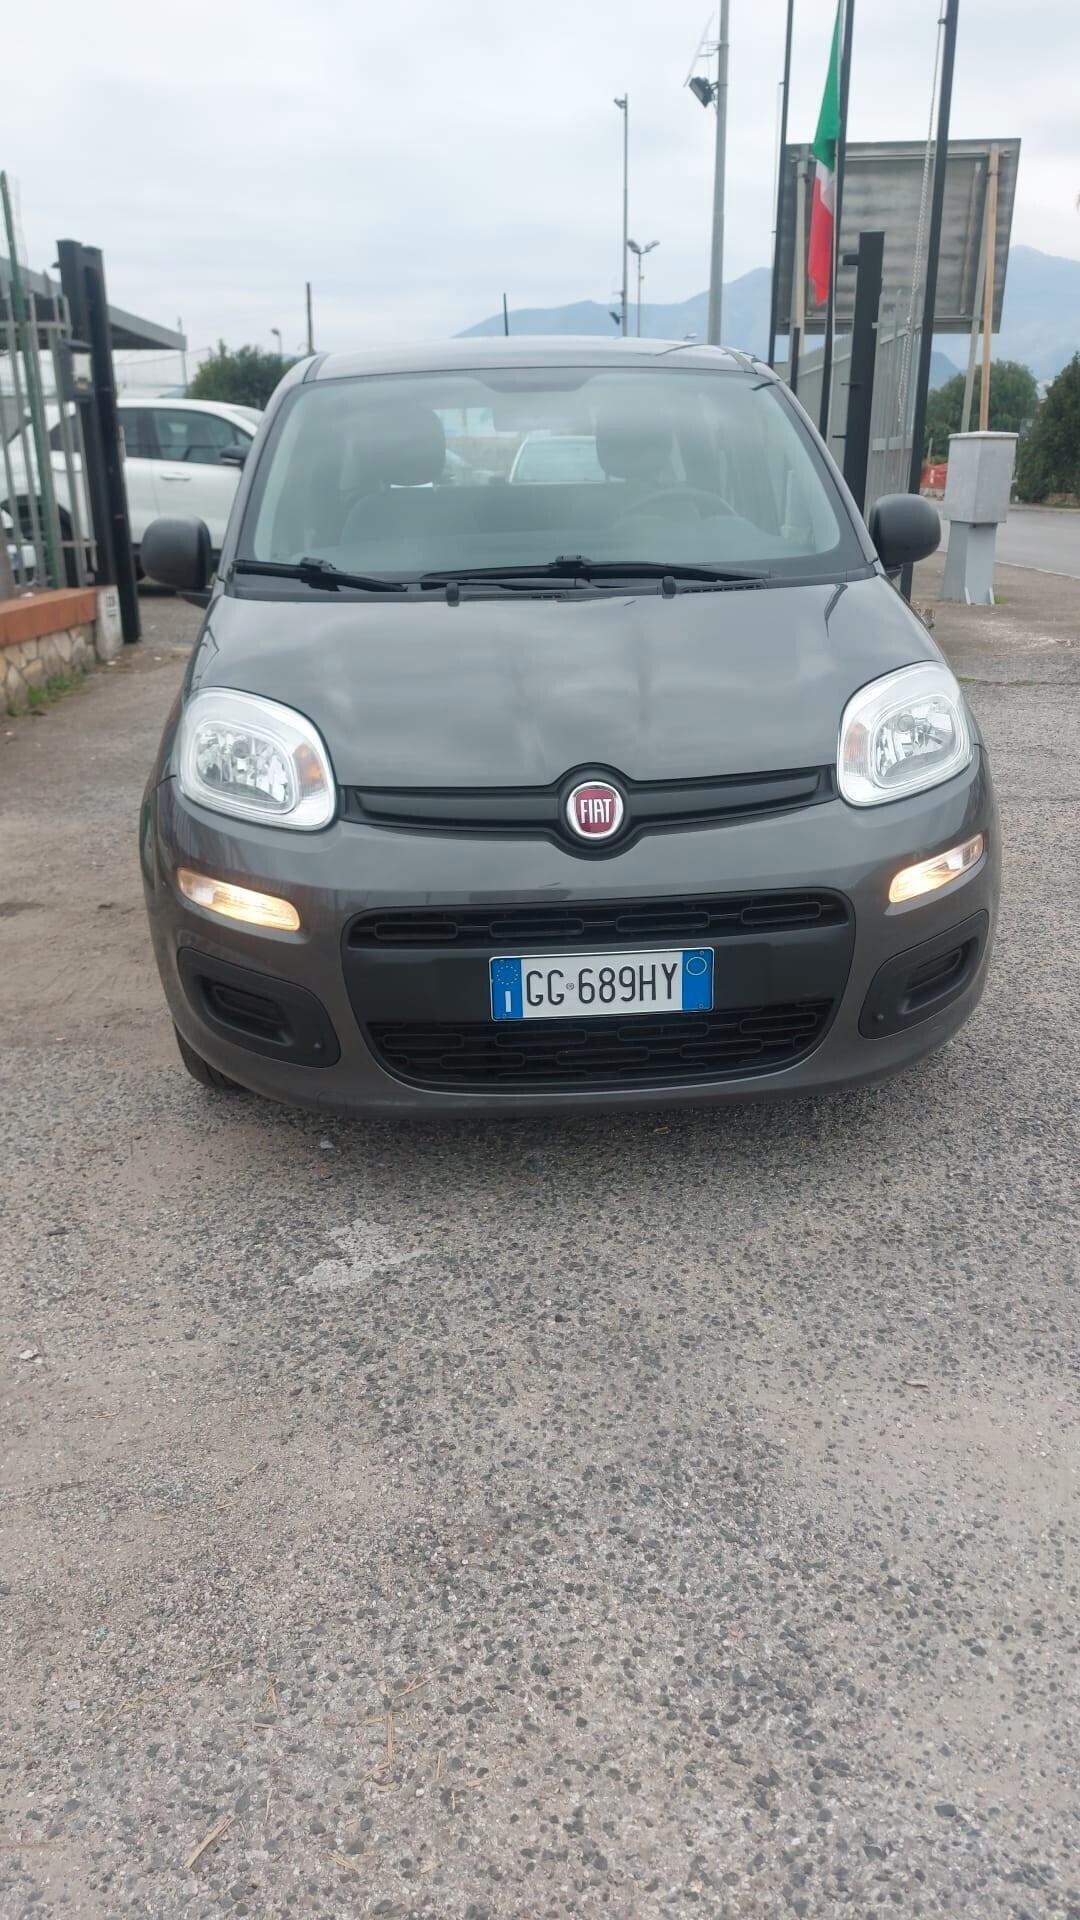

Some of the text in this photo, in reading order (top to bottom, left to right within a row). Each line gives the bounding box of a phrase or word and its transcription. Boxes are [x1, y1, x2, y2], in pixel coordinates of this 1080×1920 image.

[580, 798, 612, 824] FIAT
[526, 963, 678, 1006] GG 689HY
[504, 990, 512, 1013] I
